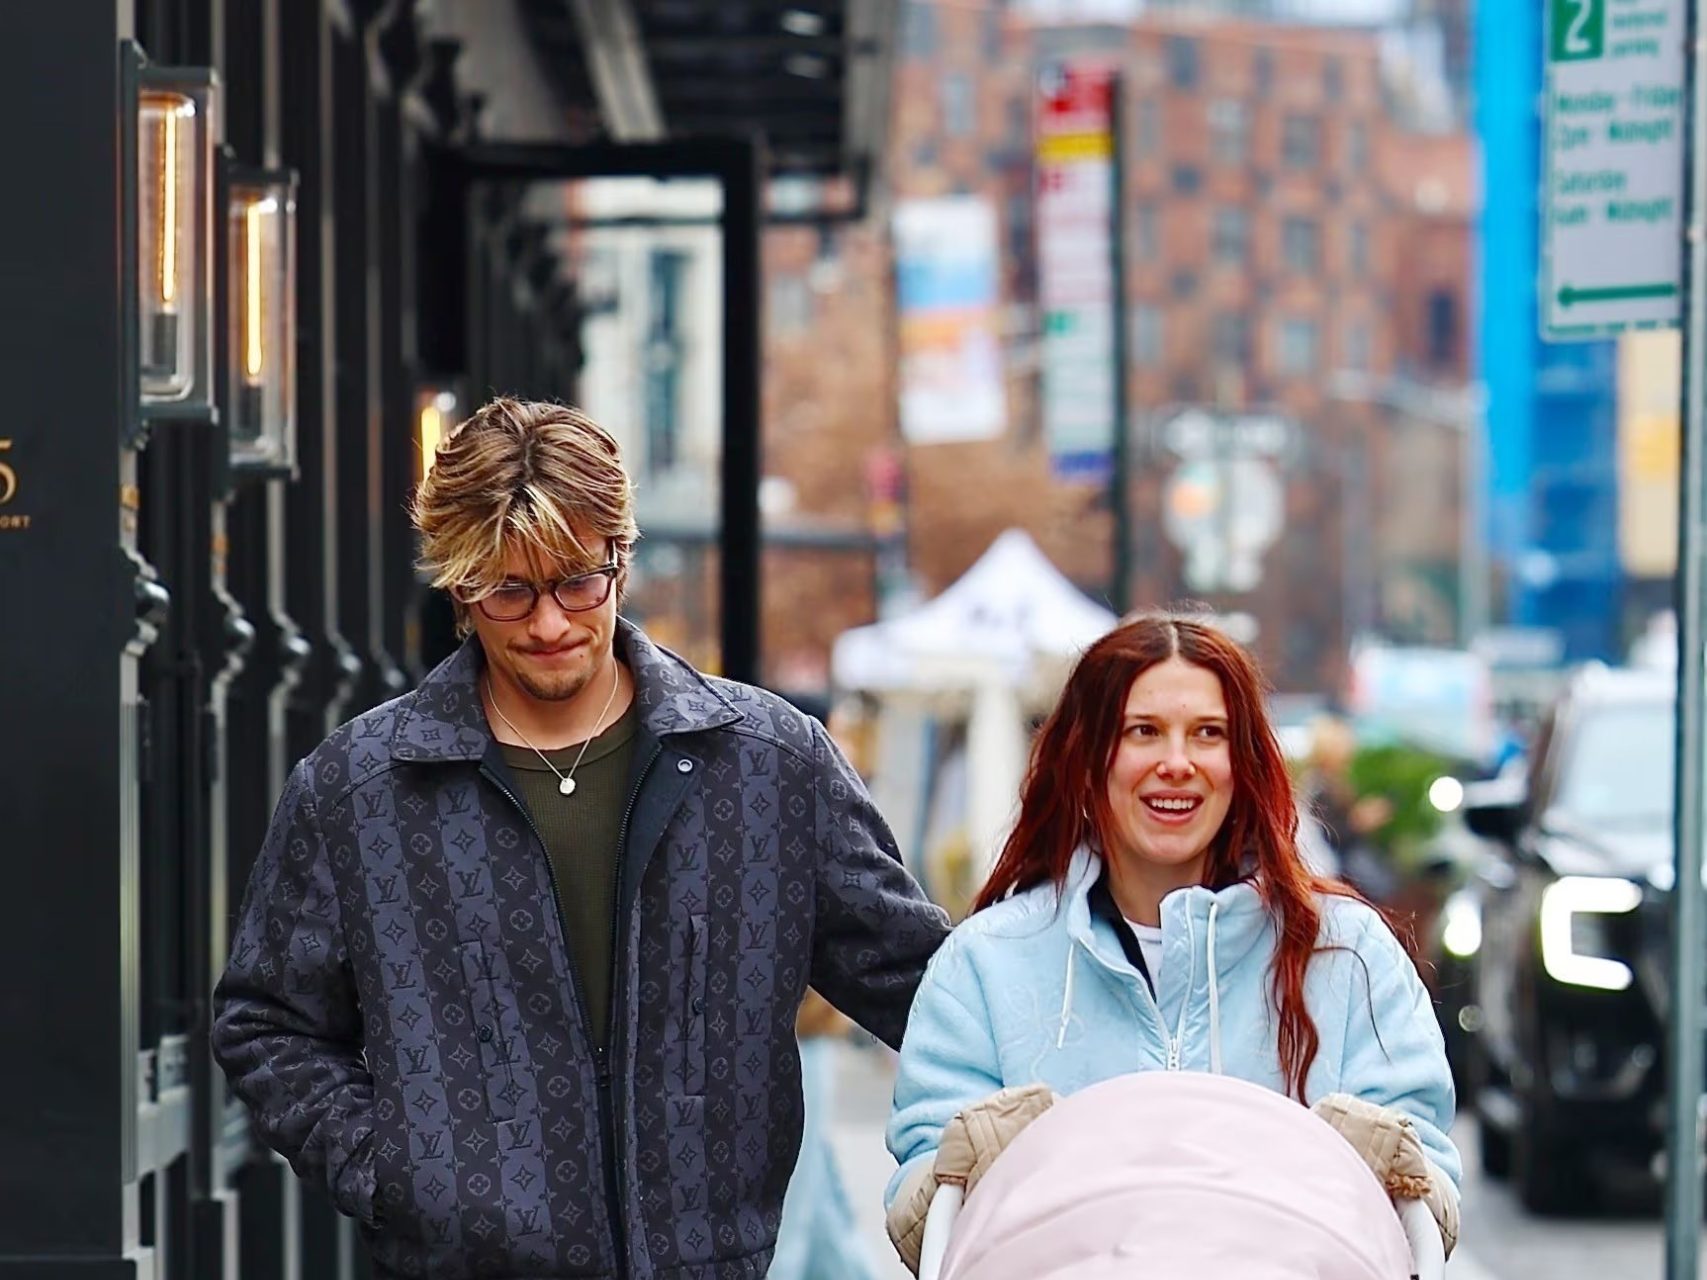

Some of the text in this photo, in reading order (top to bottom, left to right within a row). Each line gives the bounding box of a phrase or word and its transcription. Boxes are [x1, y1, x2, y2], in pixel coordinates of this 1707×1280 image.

[748, 749, 770, 777] LV
[361, 789, 387, 820] LV
[676, 843, 700, 871] LV
[749, 834, 771, 863] LV
[372, 874, 400, 904] LV
[455, 868, 485, 899] LV
[745, 921, 771, 950] LV
[389, 961, 417, 990] LV
[744, 1010, 766, 1036] LV
[402, 1046, 431, 1076] LV
[674, 1103, 698, 1128] LV
[414, 1130, 444, 1160] LV
[503, 1120, 534, 1151] LV
[680, 1185, 701, 1212] LV
[513, 1205, 544, 1237] LV
